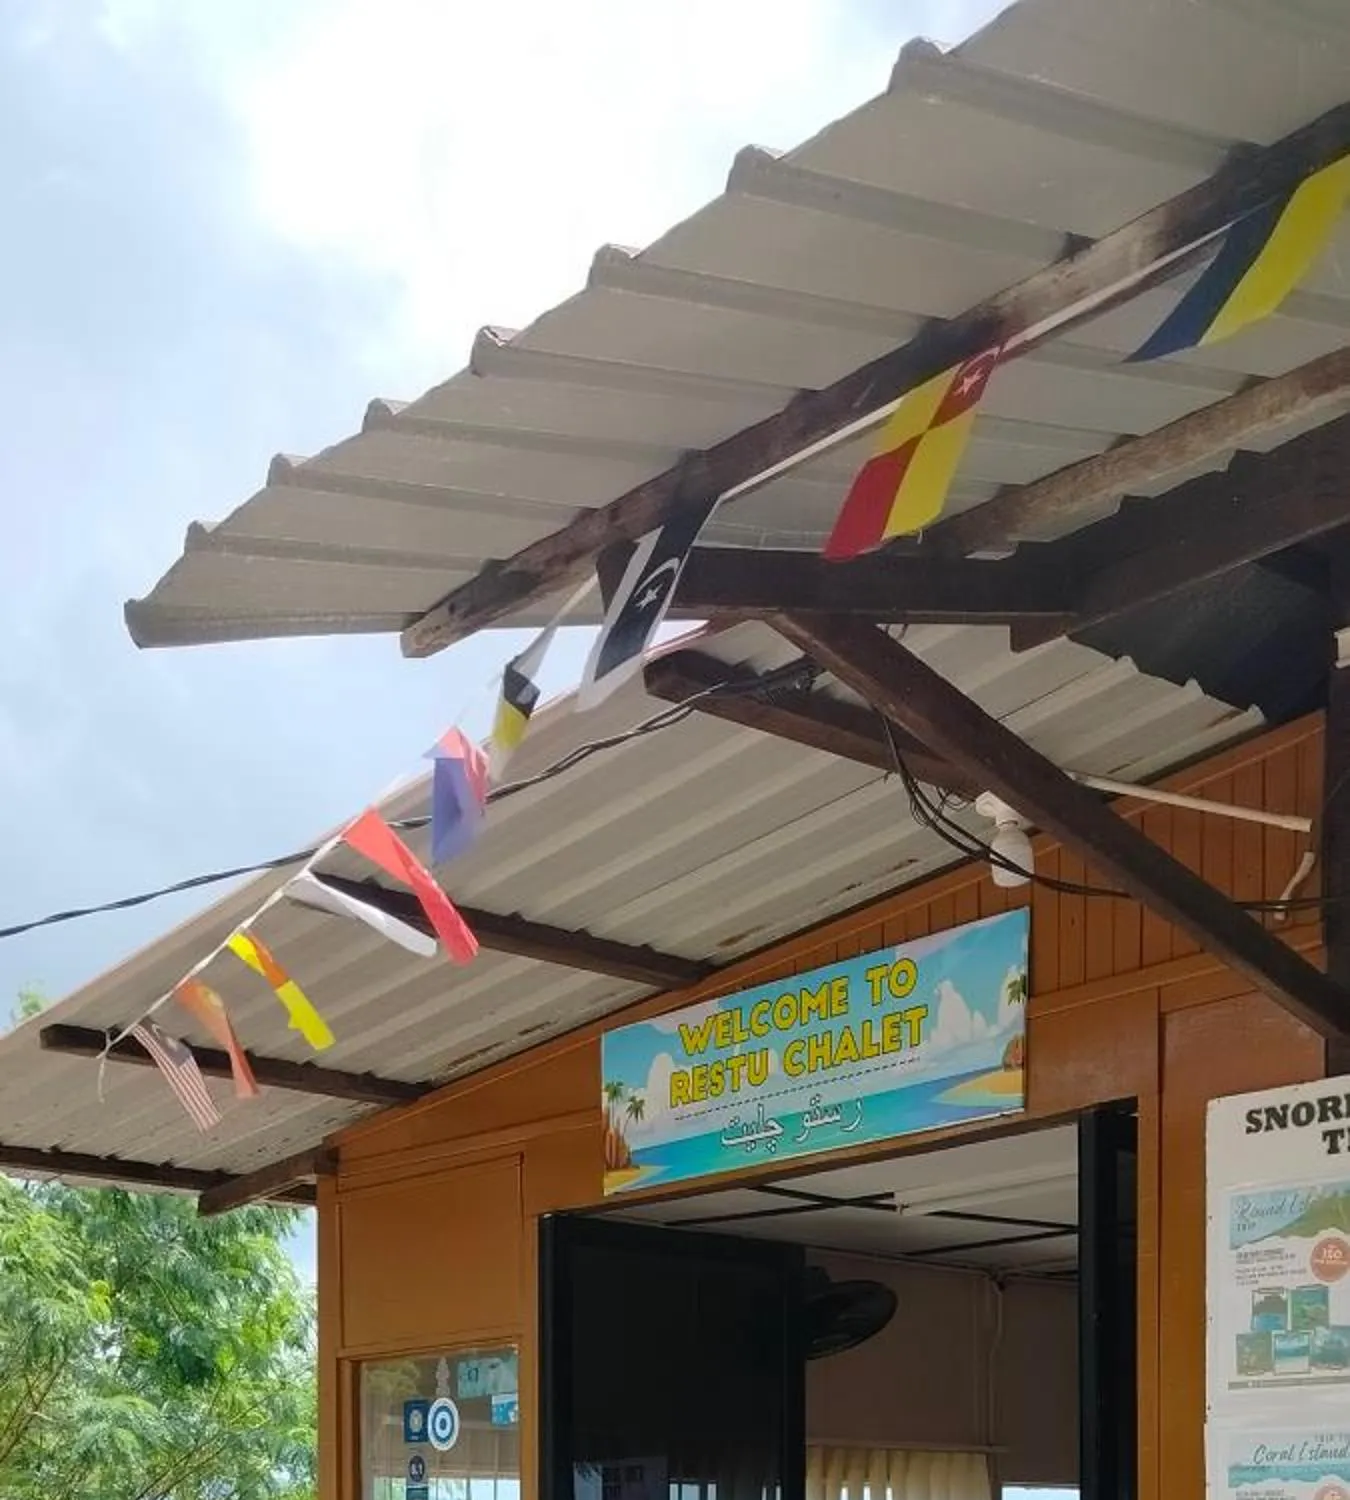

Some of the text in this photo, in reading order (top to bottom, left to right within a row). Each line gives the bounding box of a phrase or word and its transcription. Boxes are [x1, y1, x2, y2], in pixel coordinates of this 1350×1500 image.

[679, 957, 918, 1054] WELCOME TO
[669, 1005, 929, 1109] RESTU CHALET
[1253, 1443, 1295, 1465] Coral
